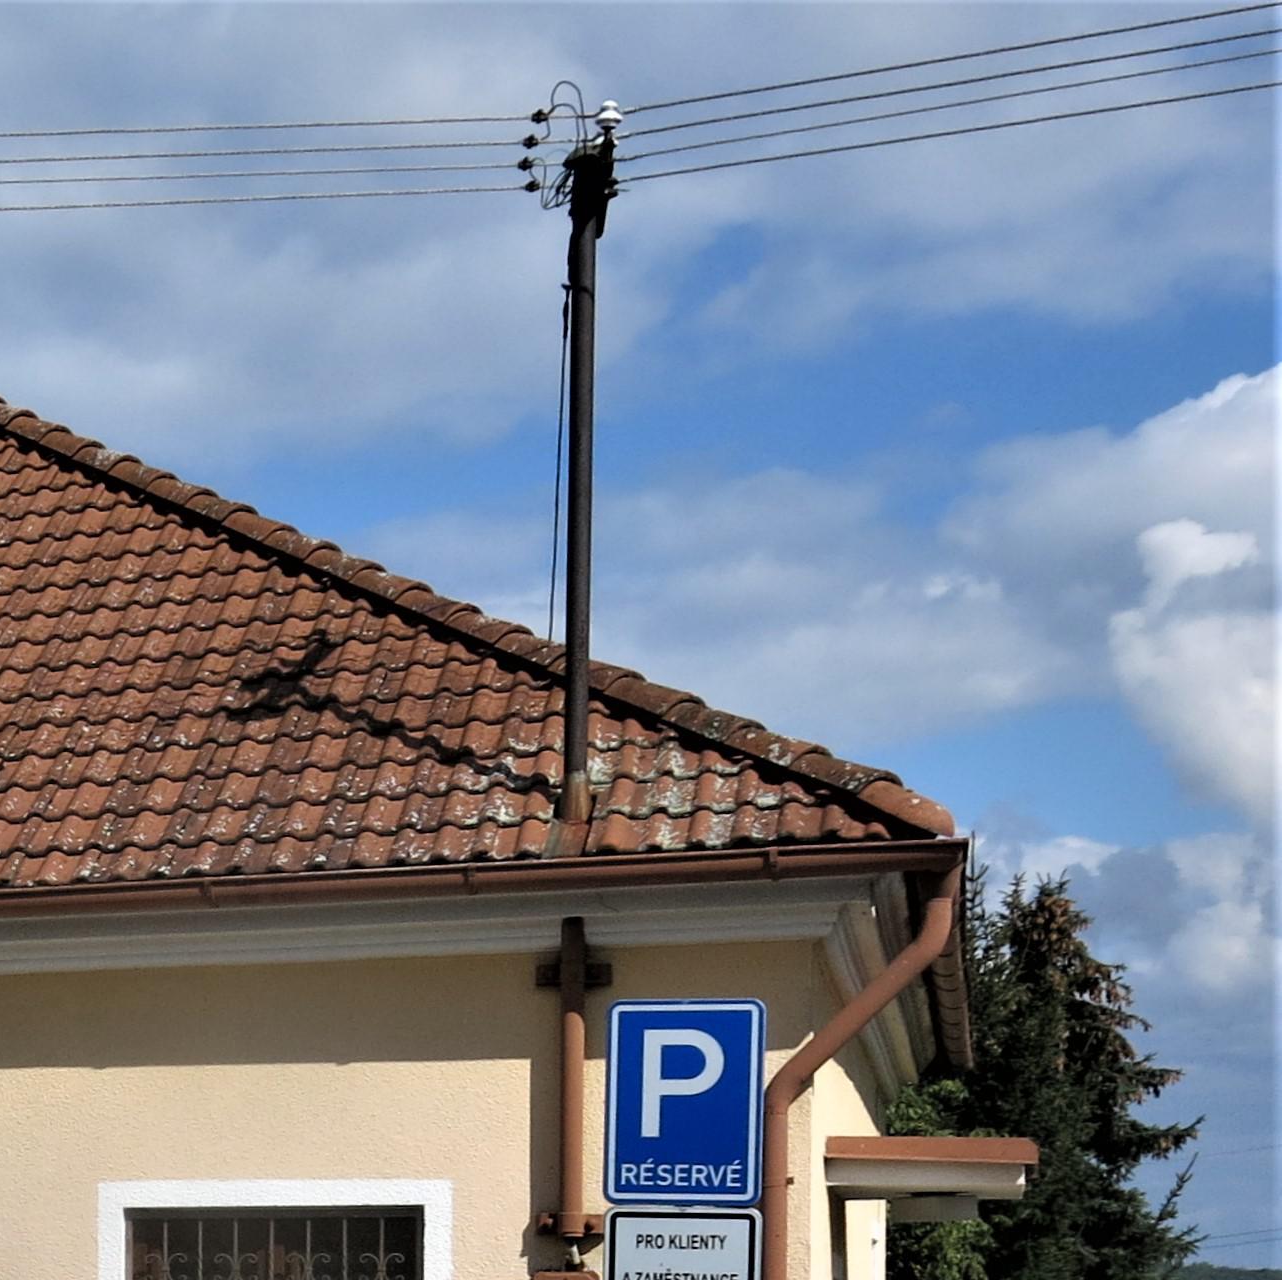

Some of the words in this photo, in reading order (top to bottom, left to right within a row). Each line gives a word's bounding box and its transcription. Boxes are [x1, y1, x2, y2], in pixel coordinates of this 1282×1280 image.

[640, 1028, 725, 1138] P
[620, 1158, 742, 1188] RÉSERVÉ
[636, 1234, 665, 1249] PRO
[668, 1235, 727, 1250] KLIENTY
